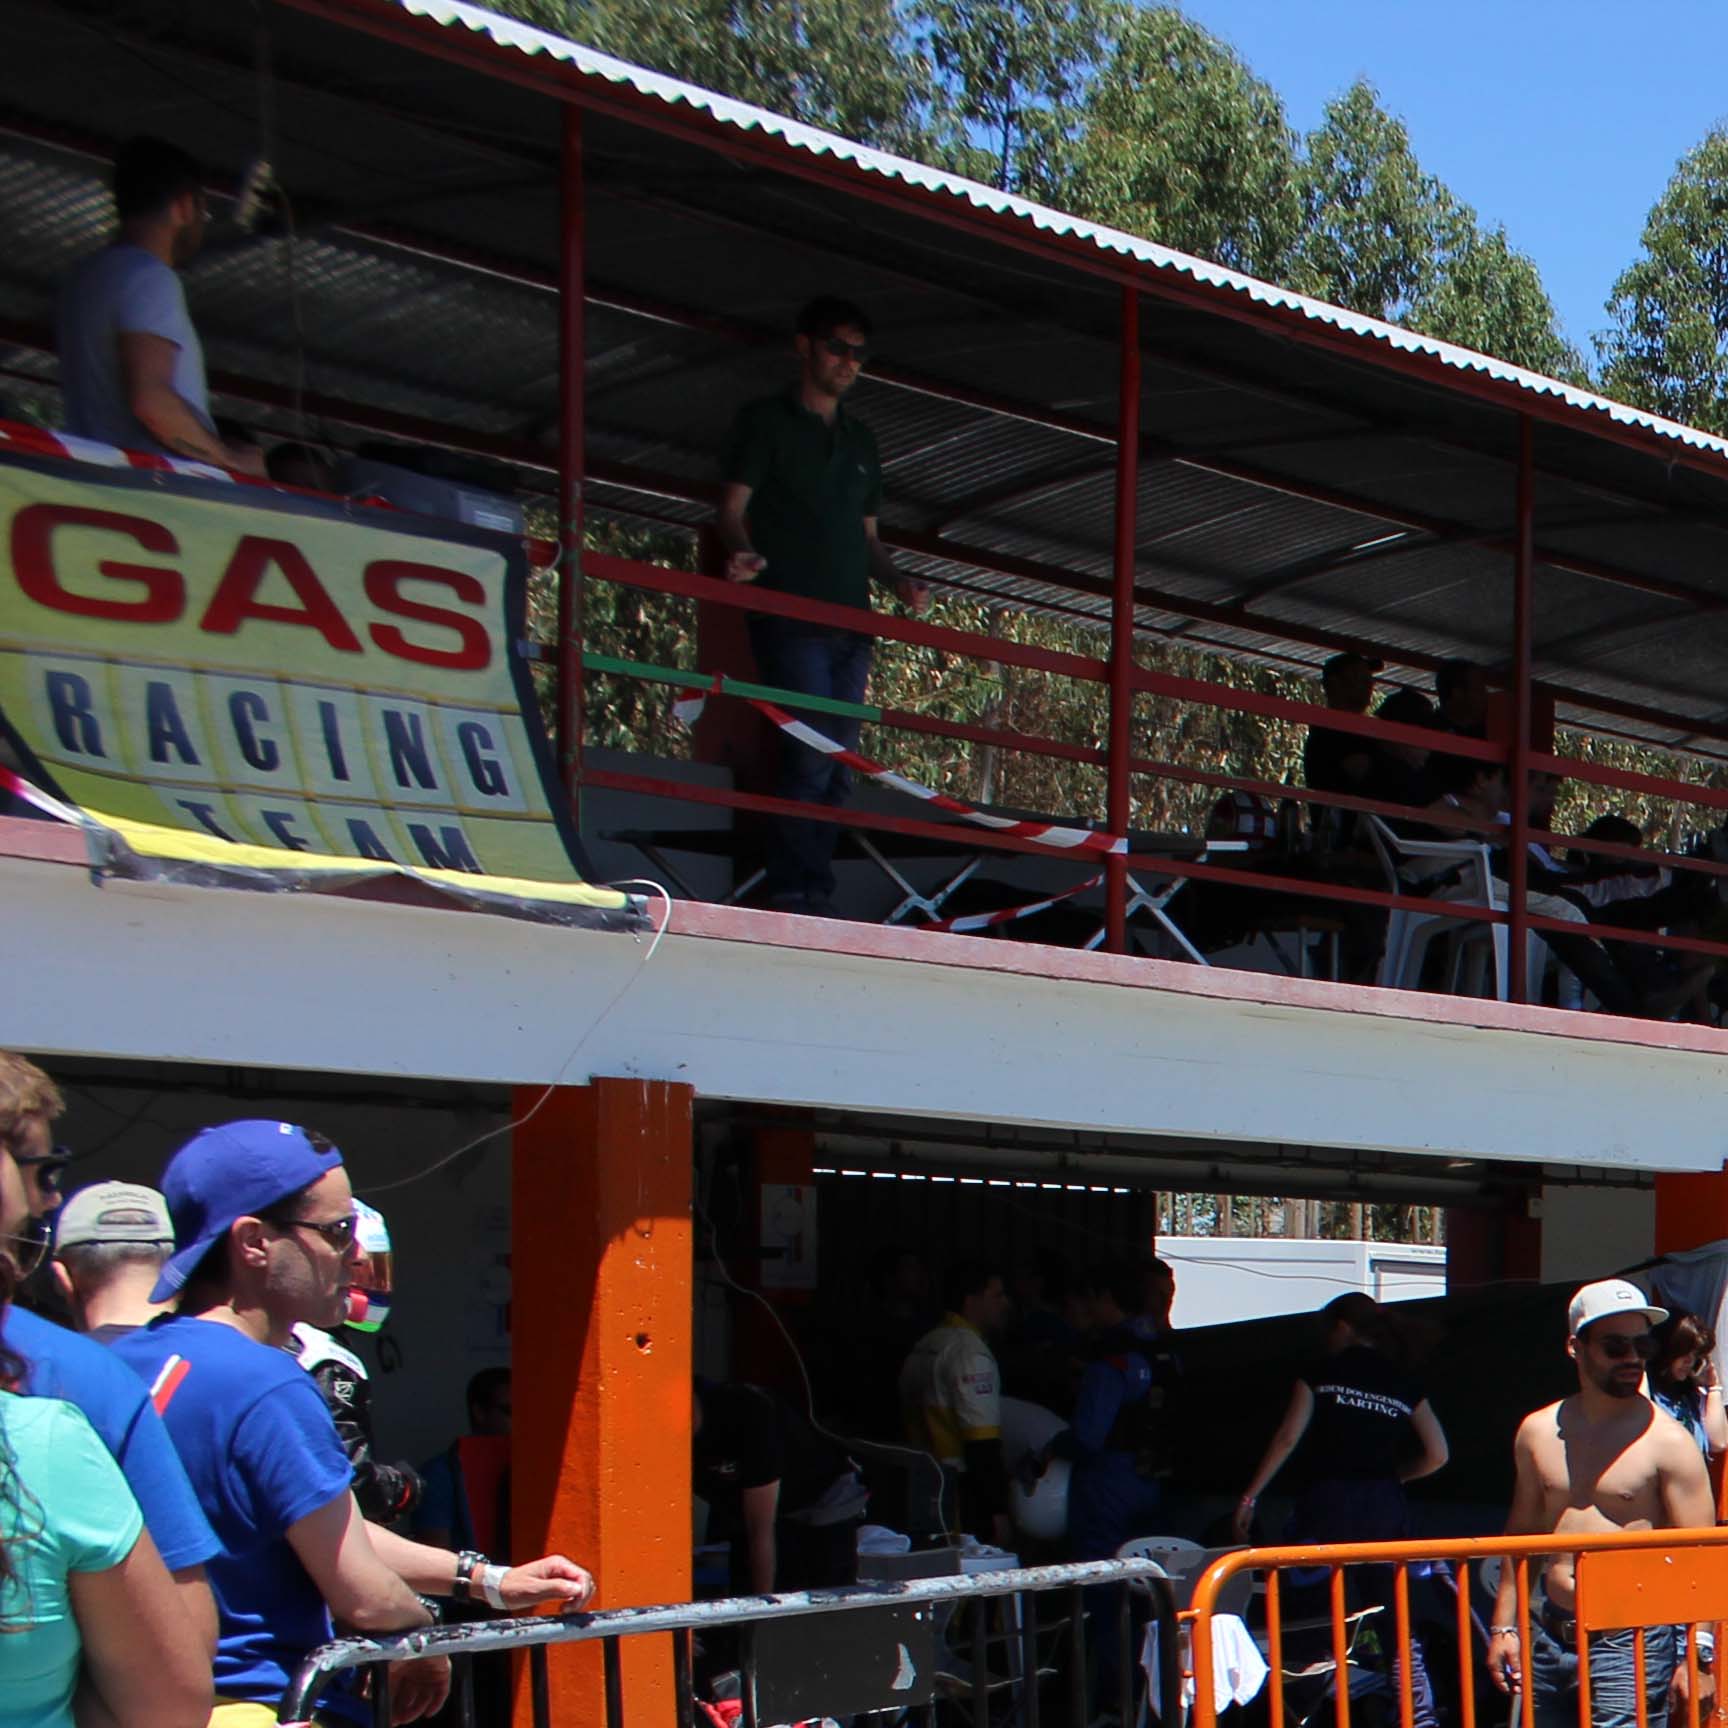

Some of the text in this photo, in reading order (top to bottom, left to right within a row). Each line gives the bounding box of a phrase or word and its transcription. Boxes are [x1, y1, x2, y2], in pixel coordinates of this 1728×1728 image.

[10, 502, 492, 671] GAS
[45, 670, 508, 797] RACING
[1336, 1394, 1398, 1418] KARTING
